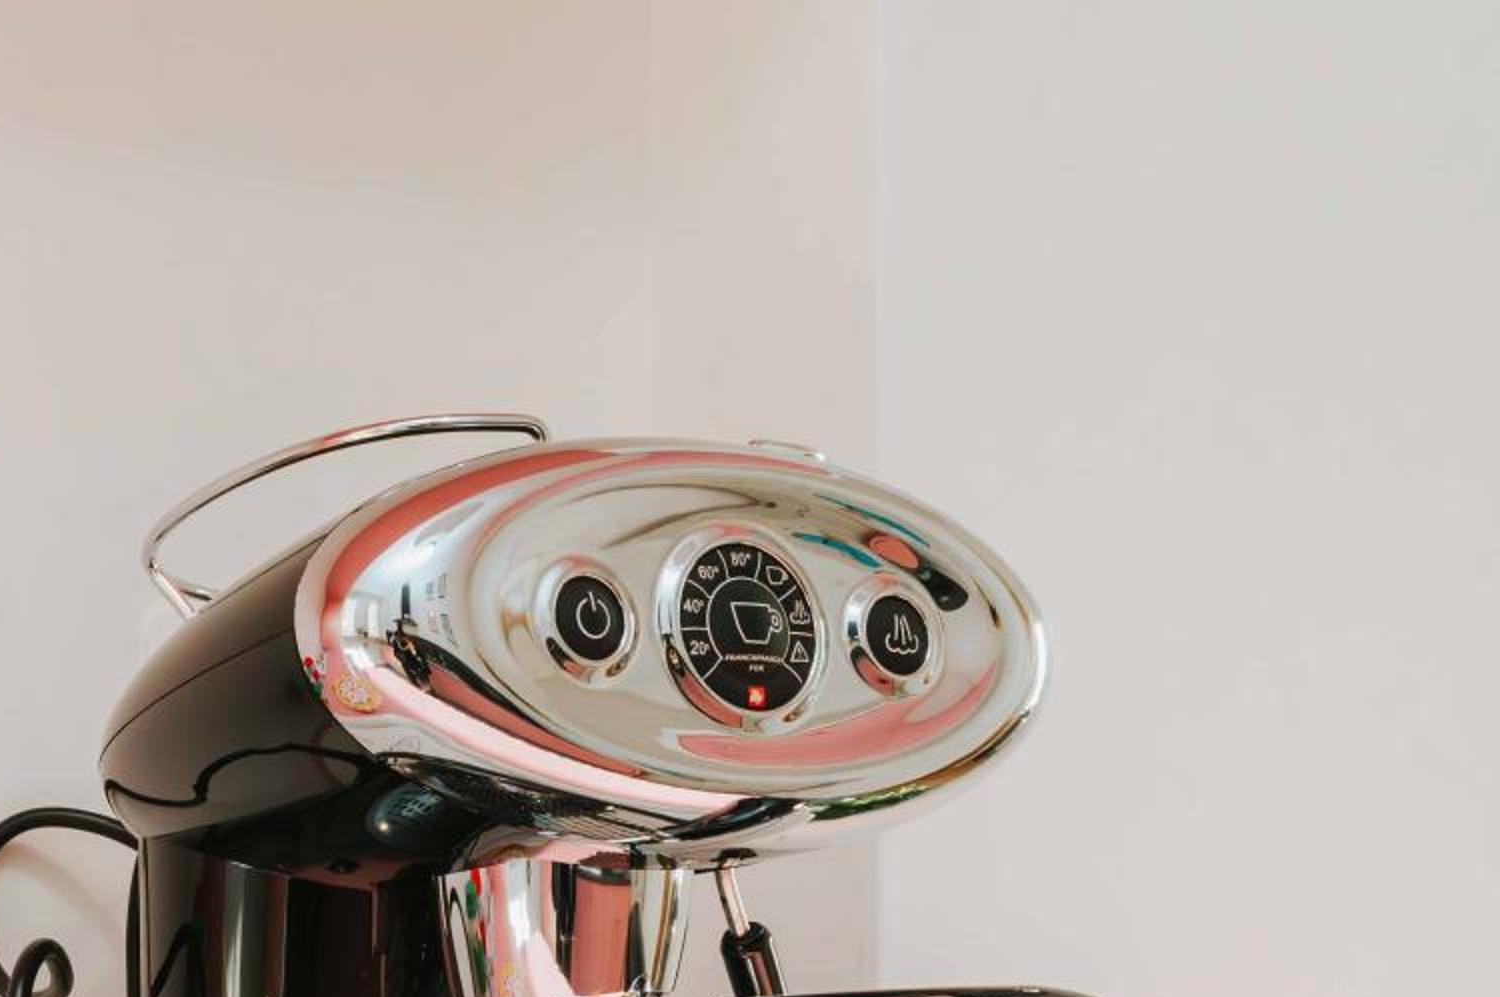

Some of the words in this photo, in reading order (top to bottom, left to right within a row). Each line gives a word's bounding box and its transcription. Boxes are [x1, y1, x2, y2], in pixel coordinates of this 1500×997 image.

[698, 565, 719, 579] 60°
[684, 599, 705, 613] 40°
[690, 641, 710, 655] 20°
